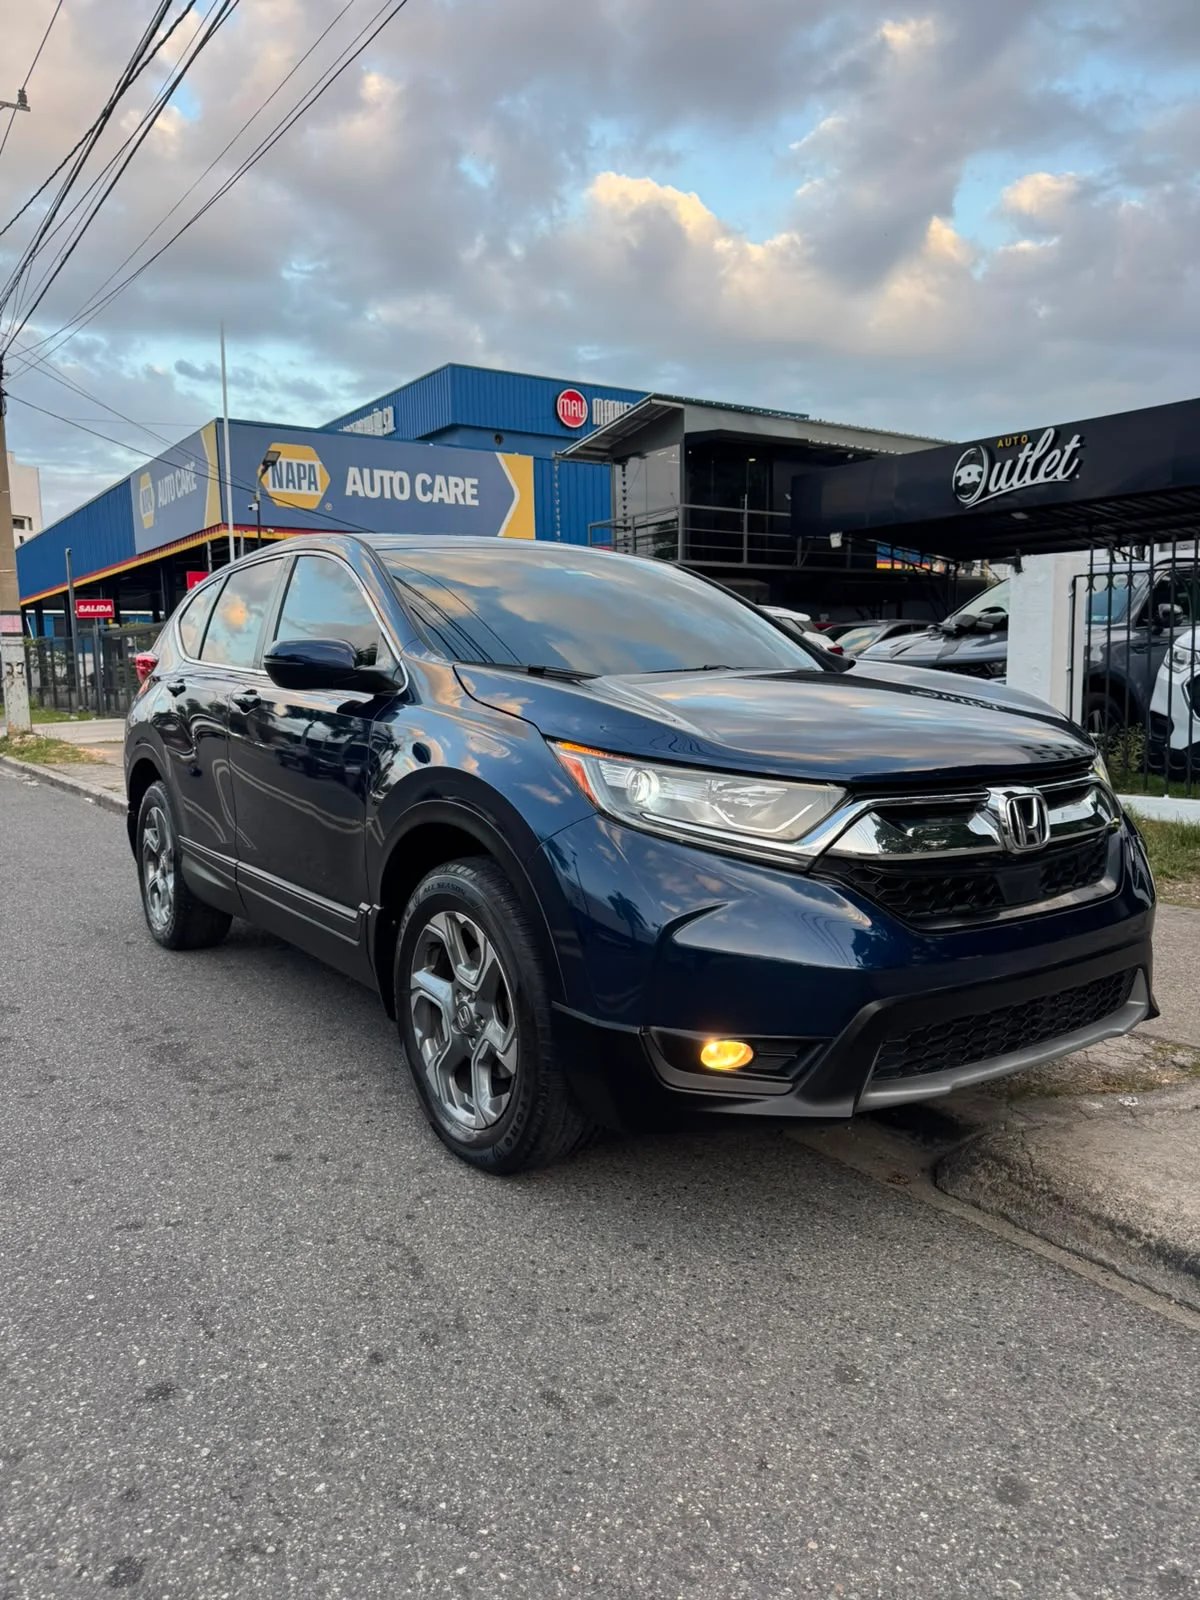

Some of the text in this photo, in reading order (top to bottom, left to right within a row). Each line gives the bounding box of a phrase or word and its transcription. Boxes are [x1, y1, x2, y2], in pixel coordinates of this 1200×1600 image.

[560, 398, 585, 418] MAU
[997, 434, 1029, 449] AUTO
[158, 472, 175, 508] AUTO
[175, 461, 197, 498] CARE
[271, 460, 319, 492] NAPA
[345, 466, 480, 506] AUTO CARE
[78, 604, 112, 613] SALIDA
